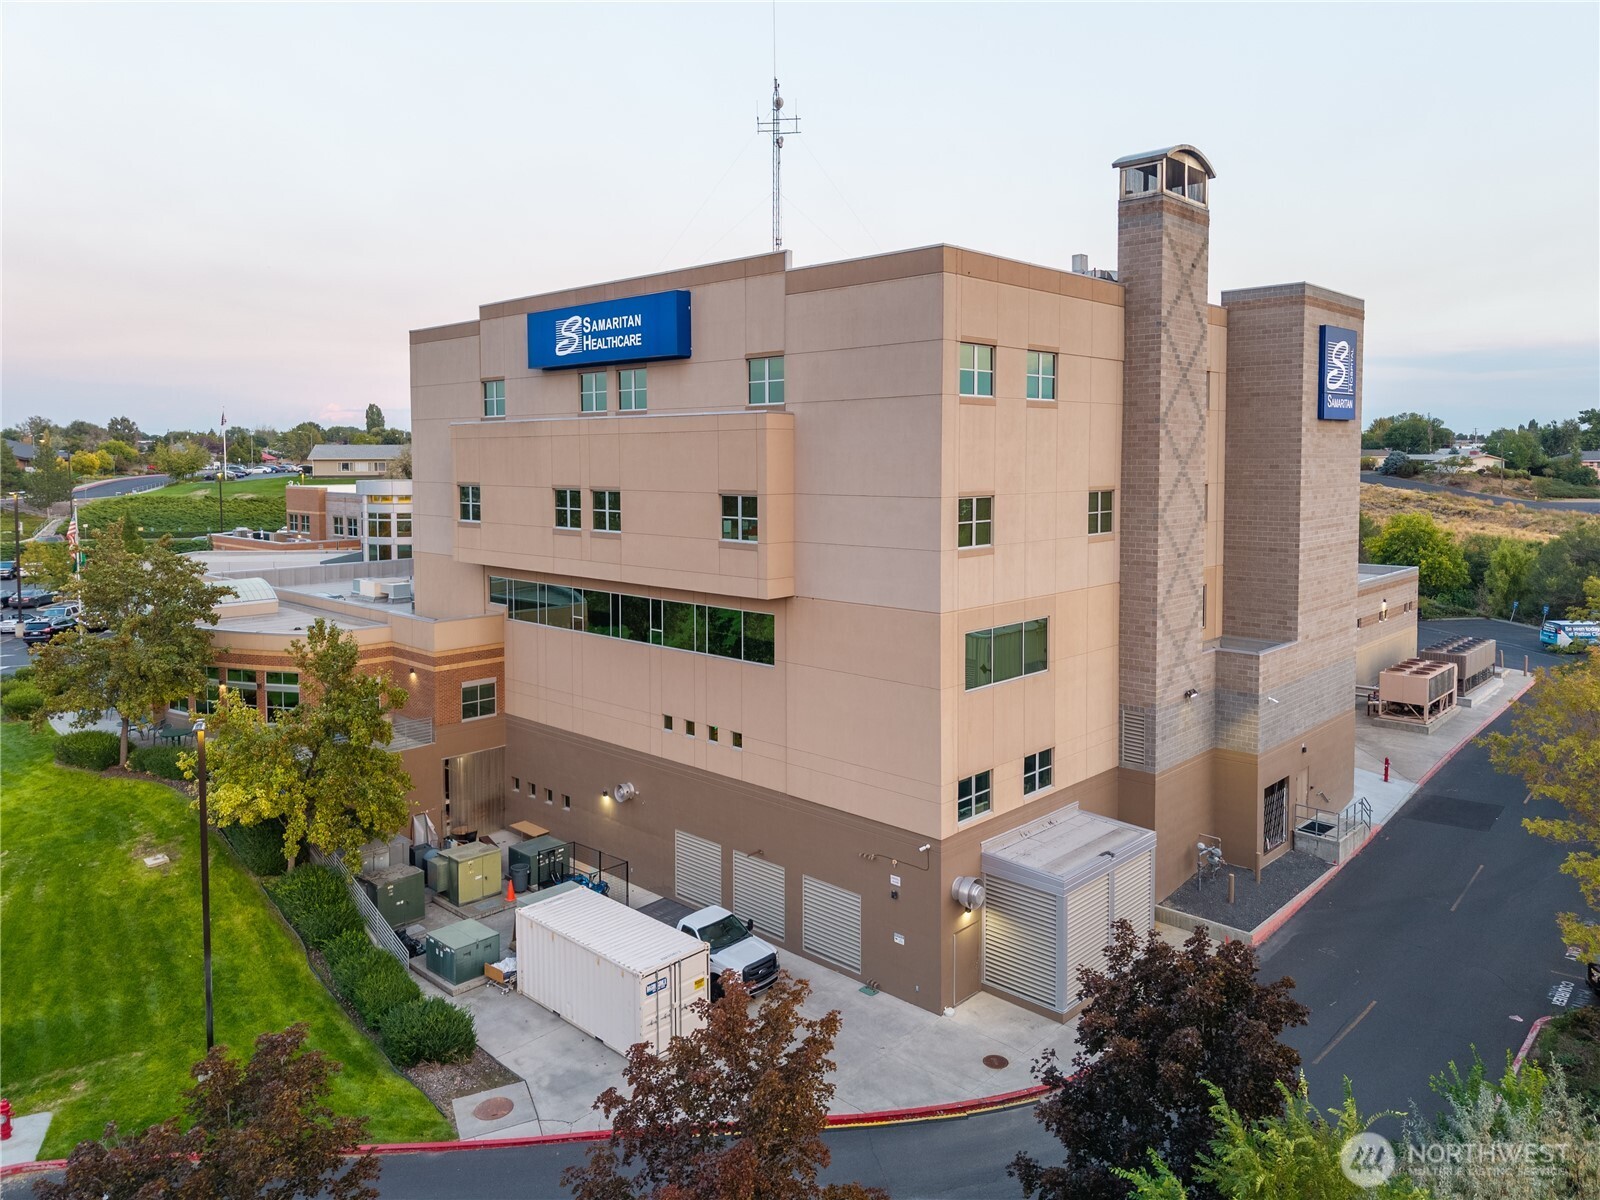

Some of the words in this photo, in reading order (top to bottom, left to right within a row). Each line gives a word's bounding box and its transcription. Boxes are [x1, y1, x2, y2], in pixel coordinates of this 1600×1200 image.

[583, 313, 642, 333] SAMARITAN
[583, 333, 642, 351] HEALTHCARE
[1327, 394, 1353, 409] SAMARITAN
[1551, 981, 1575, 1006] COURIER
